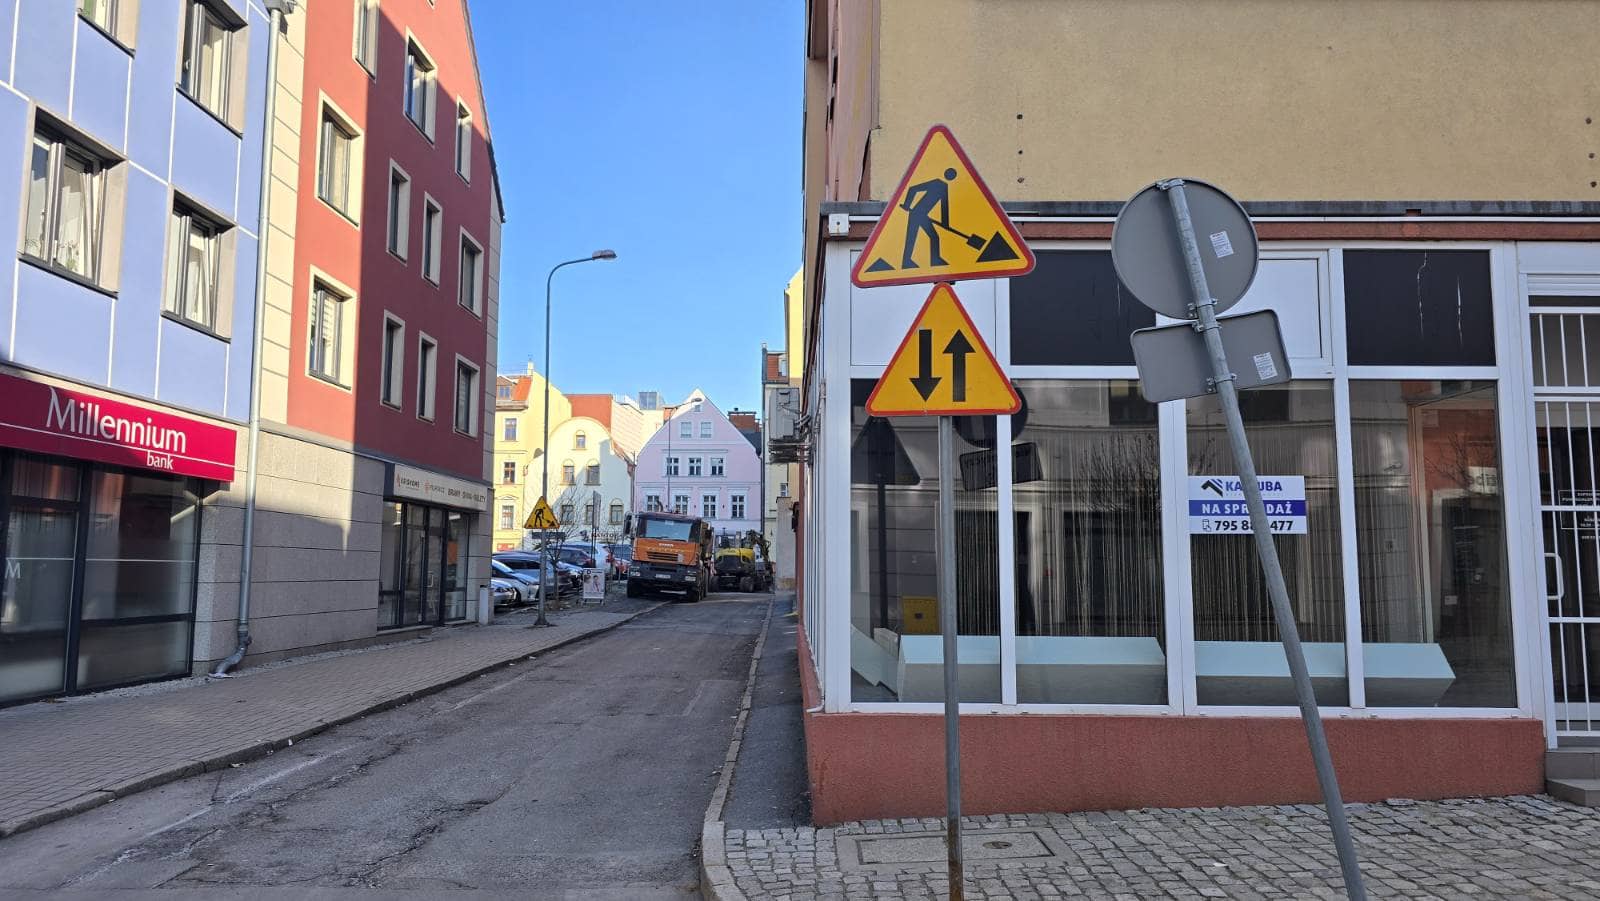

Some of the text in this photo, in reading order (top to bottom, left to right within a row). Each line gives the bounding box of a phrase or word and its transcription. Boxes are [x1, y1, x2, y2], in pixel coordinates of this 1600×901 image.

[46, 387, 186, 453] Millennium
[146, 450, 174, 470] bank
[1225, 481, 1283, 491] KAUBA
[1202, 501, 1293, 514] NA SPRDAŻ
[1214, 520, 1238, 531] 795
[1270, 520, 1294, 531] 477
[4, 560, 21, 579] M
